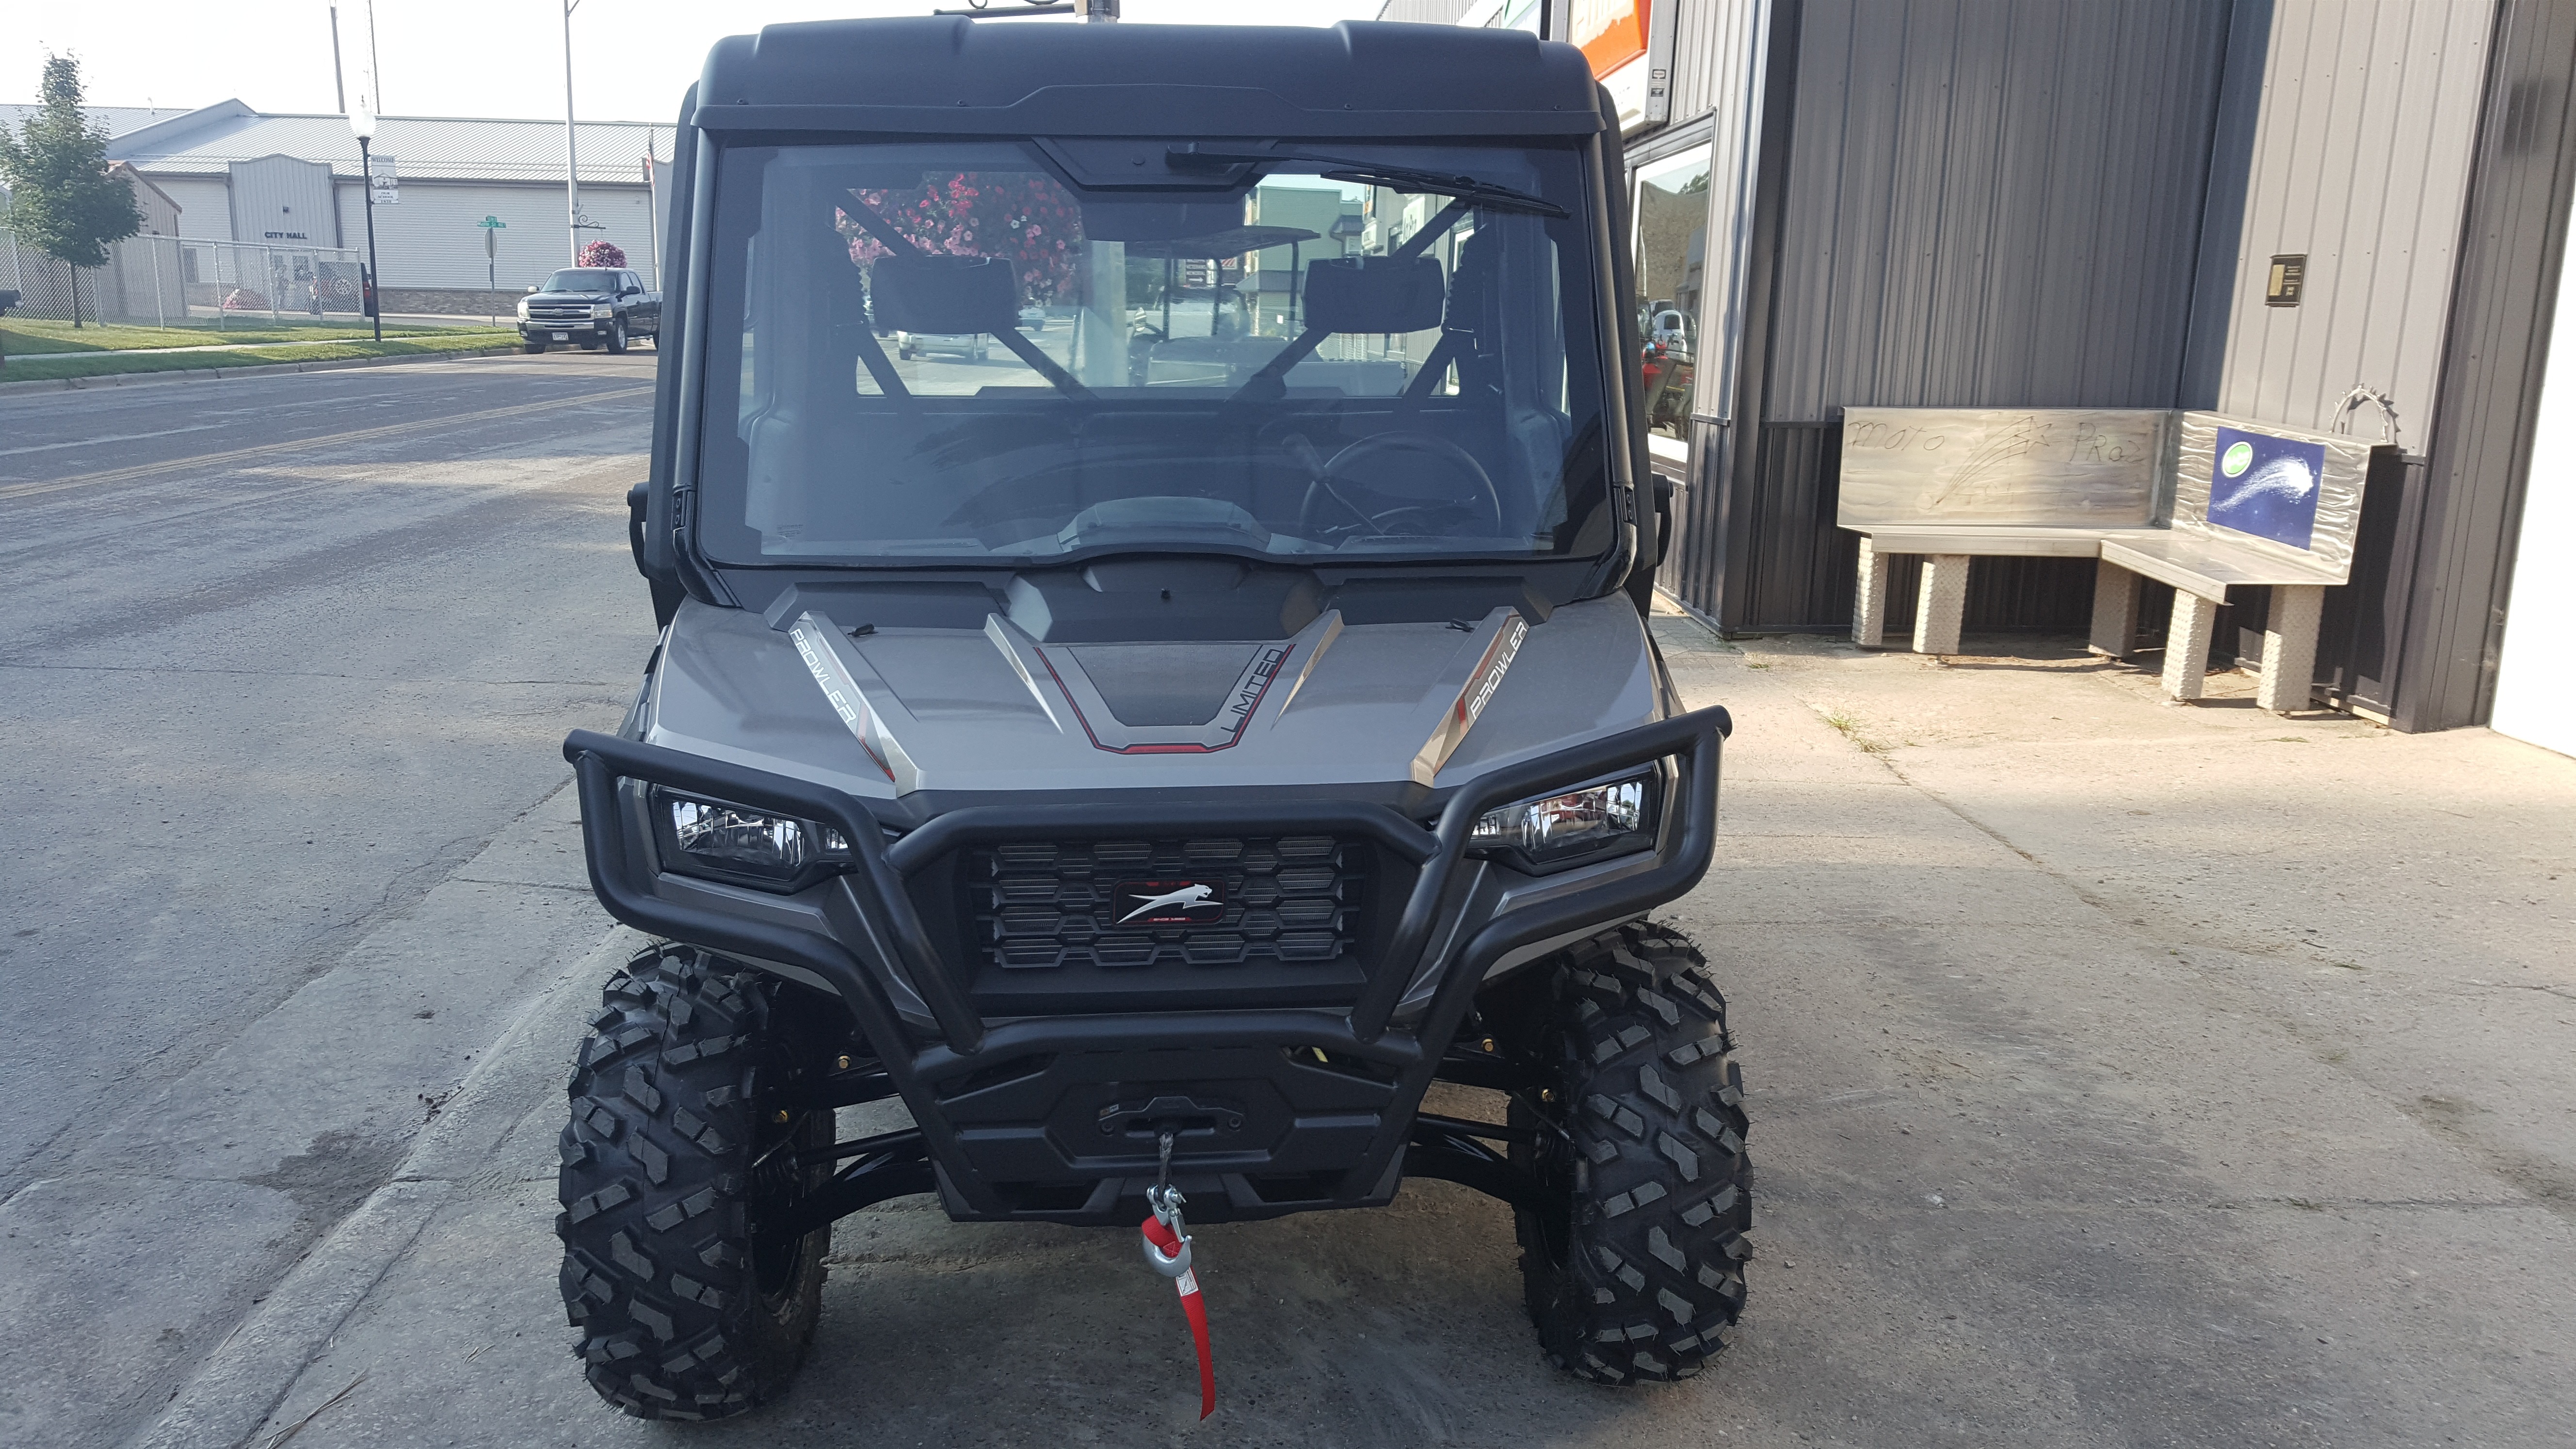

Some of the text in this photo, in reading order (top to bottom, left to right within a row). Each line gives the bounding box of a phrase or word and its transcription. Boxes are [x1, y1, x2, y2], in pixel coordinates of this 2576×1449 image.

[789, 628, 857, 724] PROWLER
[1220, 648, 1285, 733] LIMITED
[1470, 621, 1528, 720] PROWLER
